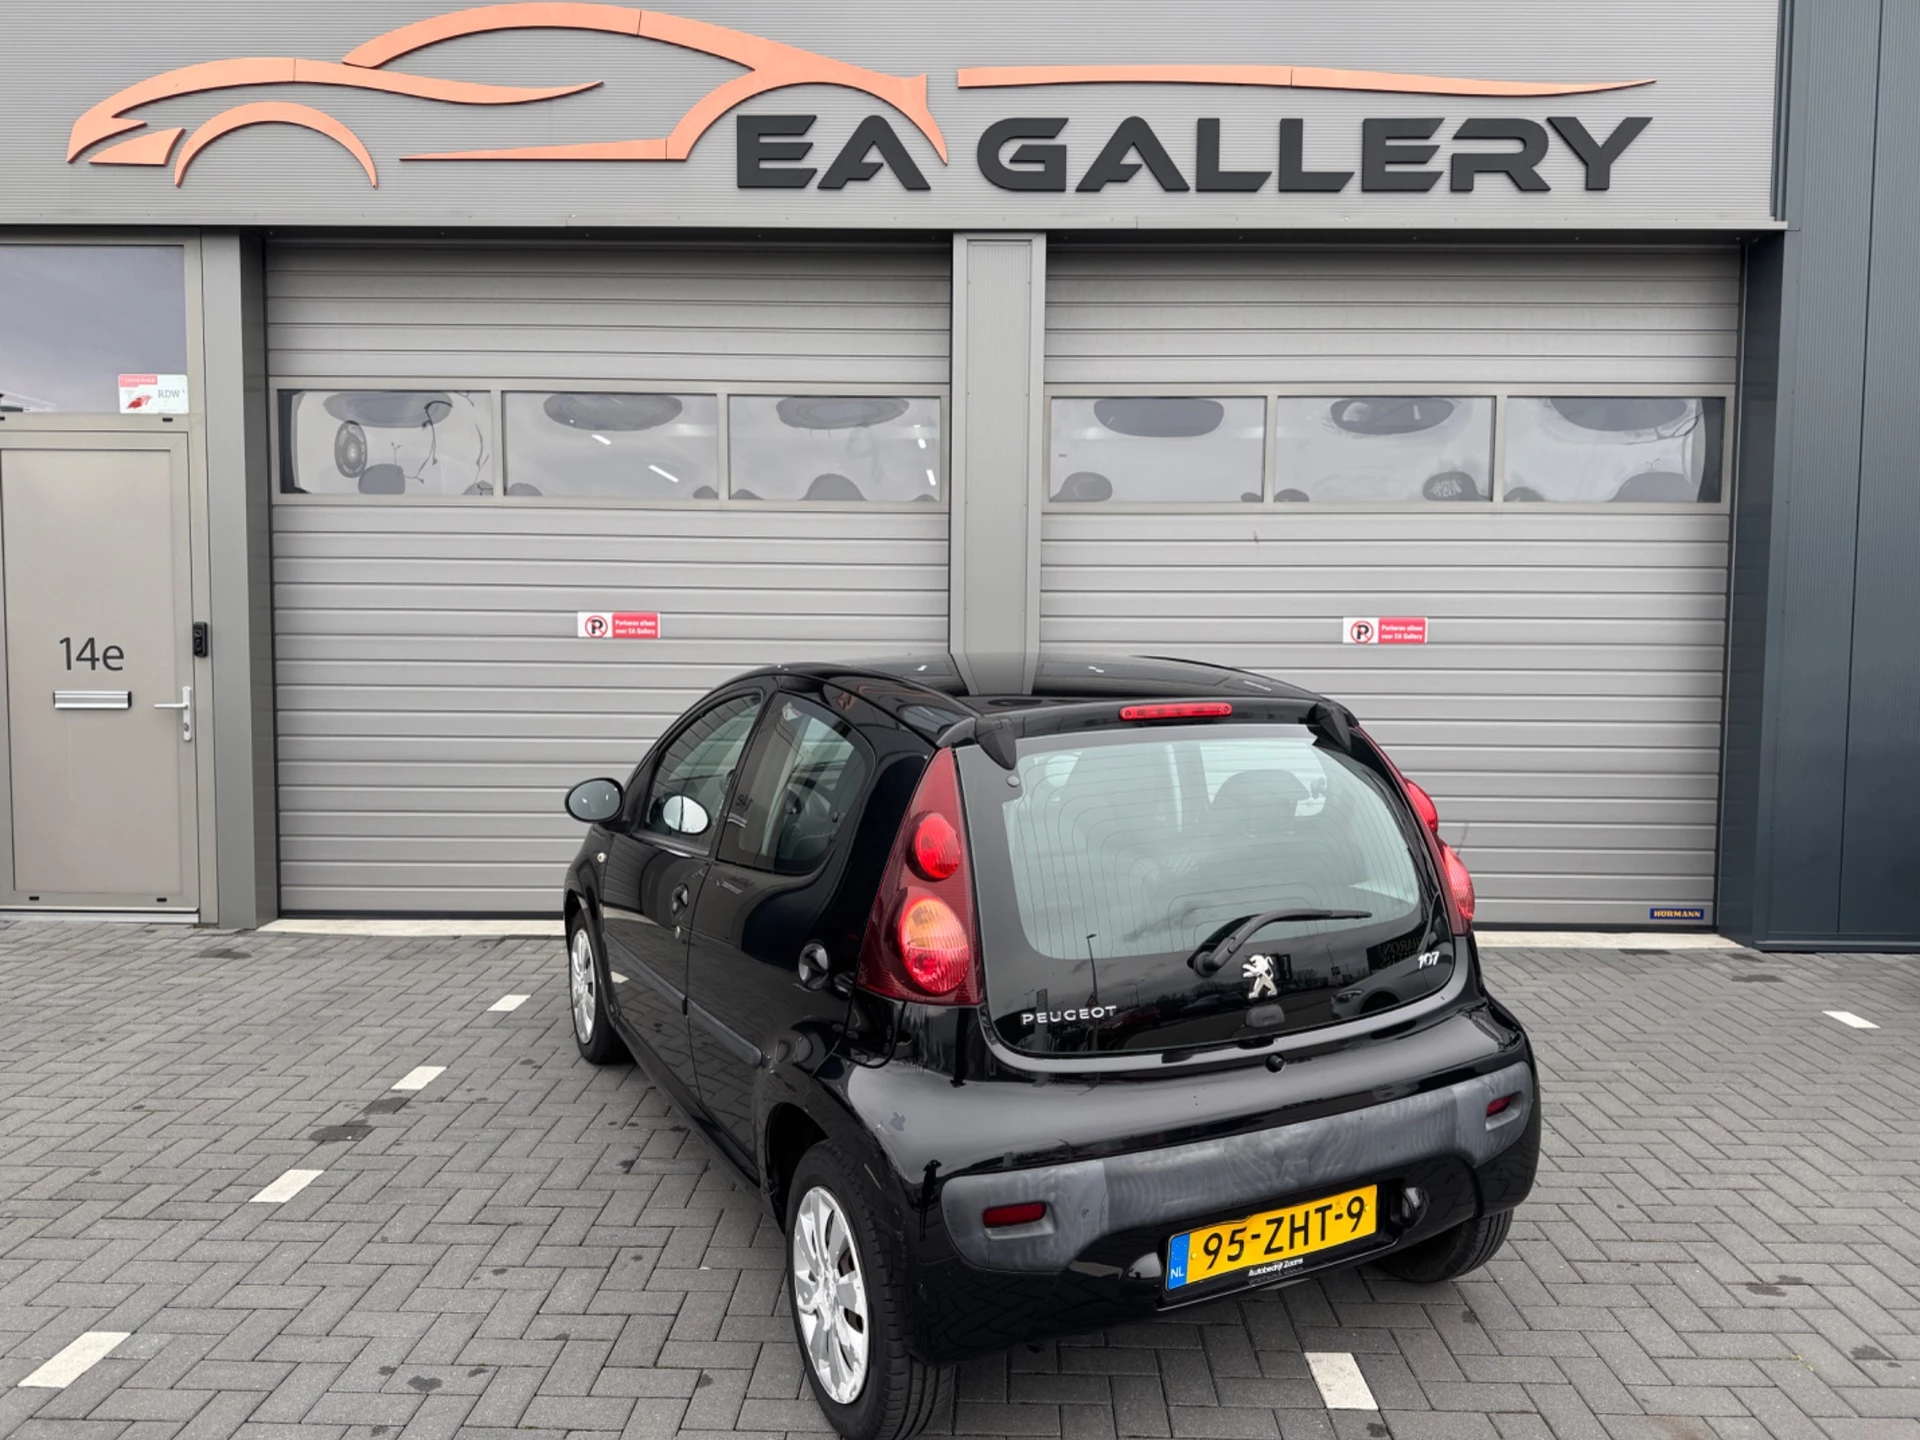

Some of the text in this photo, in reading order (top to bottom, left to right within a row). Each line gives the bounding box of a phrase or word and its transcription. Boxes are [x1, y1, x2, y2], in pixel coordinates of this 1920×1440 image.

[736, 114, 1654, 193] EA GALLERY
[158, 390, 180, 399] RDW
[59, 636, 125, 672] 14e
[1417, 951, 1440, 970] 107
[1021, 1005, 1117, 1026] PEUGEOT
[1202, 1195, 1365, 1271] 95-ZHT-9
[1170, 1267, 1185, 1280] NL
